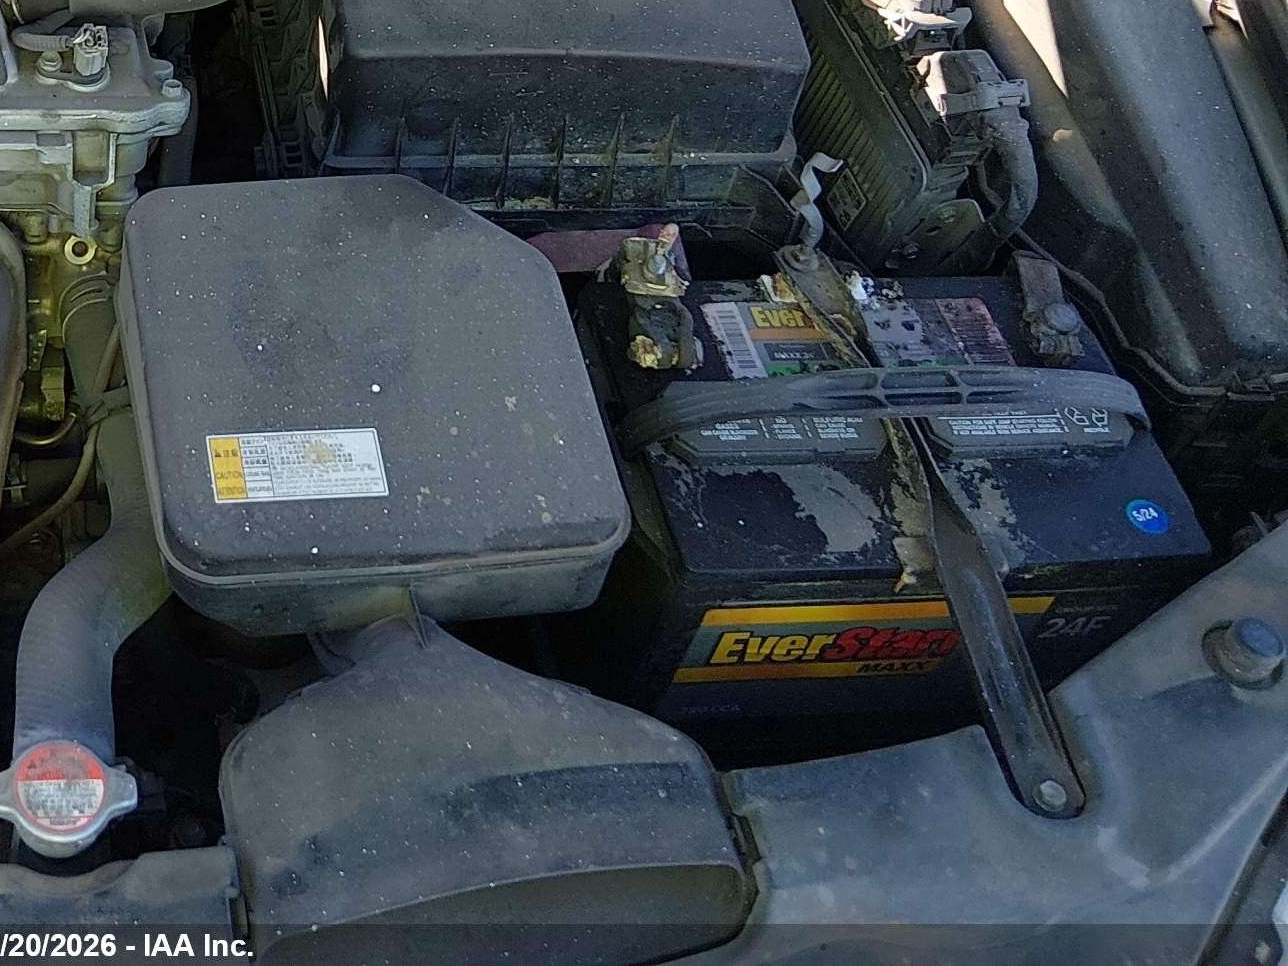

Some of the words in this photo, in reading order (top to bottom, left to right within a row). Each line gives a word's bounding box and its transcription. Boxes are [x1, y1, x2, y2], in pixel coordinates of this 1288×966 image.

[1131, 507, 1159, 522] 5/24
[1037, 615, 1113, 638] 24F
[708, 625, 962, 665] EverStar
[856, 660, 932, 674] MAXX
